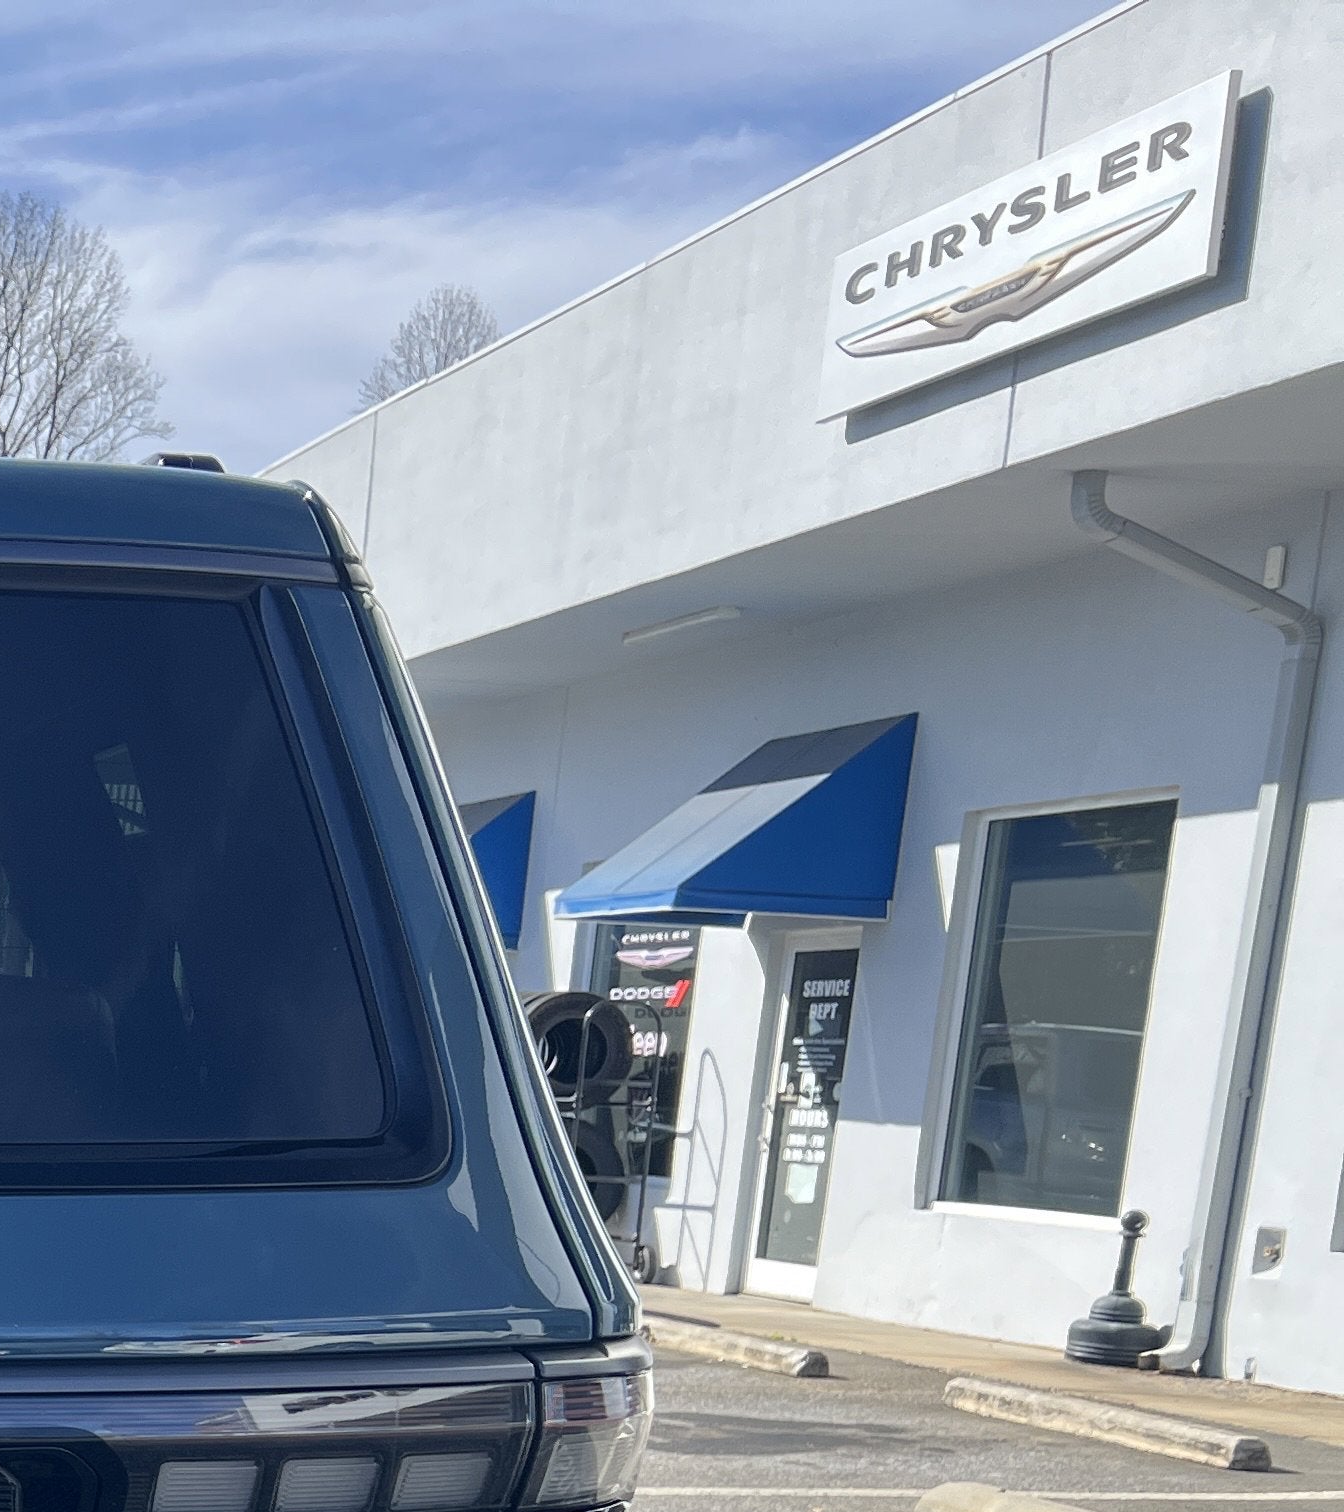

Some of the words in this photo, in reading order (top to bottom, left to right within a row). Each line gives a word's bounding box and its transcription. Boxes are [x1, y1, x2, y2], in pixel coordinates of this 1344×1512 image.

[845, 120, 1193, 305] CHRYSLER
[609, 985, 678, 1001] DODGE
[802, 979, 851, 998] SERVICE
[808, 1002, 839, 1020] DEPT
